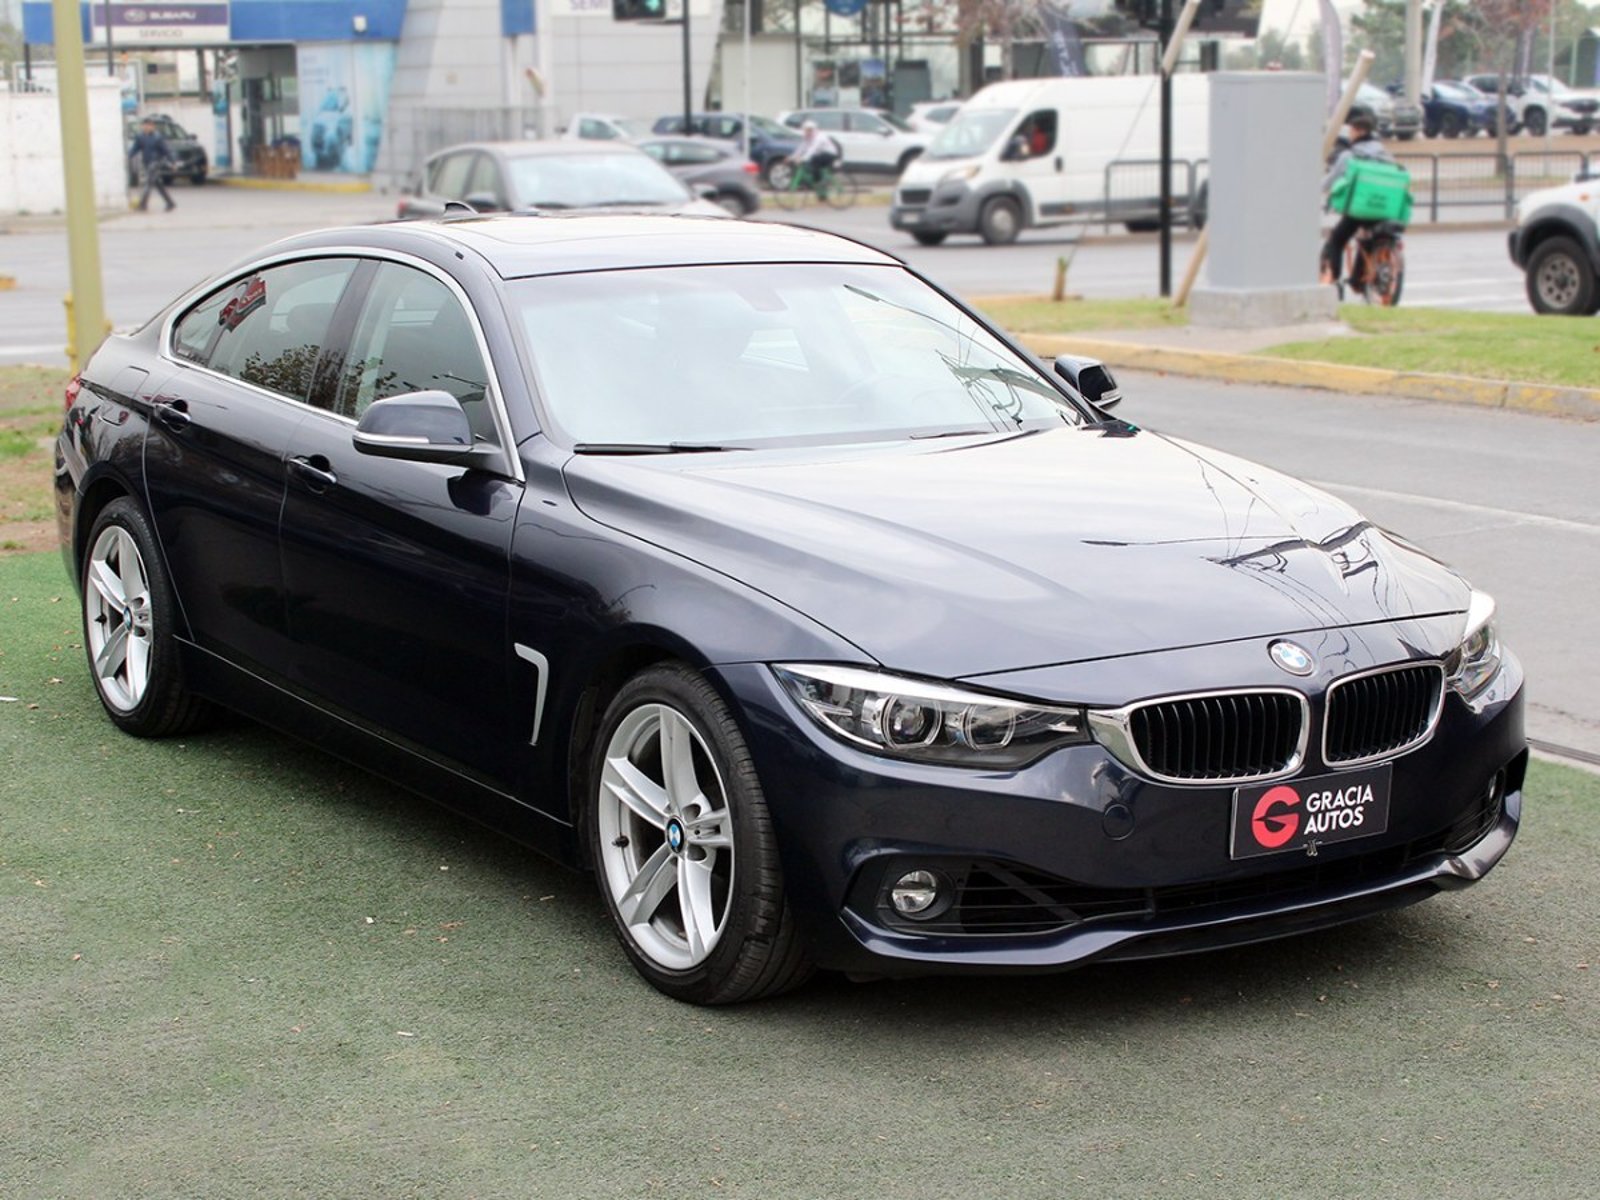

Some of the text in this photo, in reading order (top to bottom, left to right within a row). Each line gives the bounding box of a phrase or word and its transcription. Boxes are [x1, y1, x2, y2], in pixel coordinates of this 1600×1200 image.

[149, 10, 197, 20] SUBARU
[139, 28, 183, 38] SERVICIO
[1306, 784, 1374, 812] GRACIA
[1303, 806, 1364, 835] AUTOS
